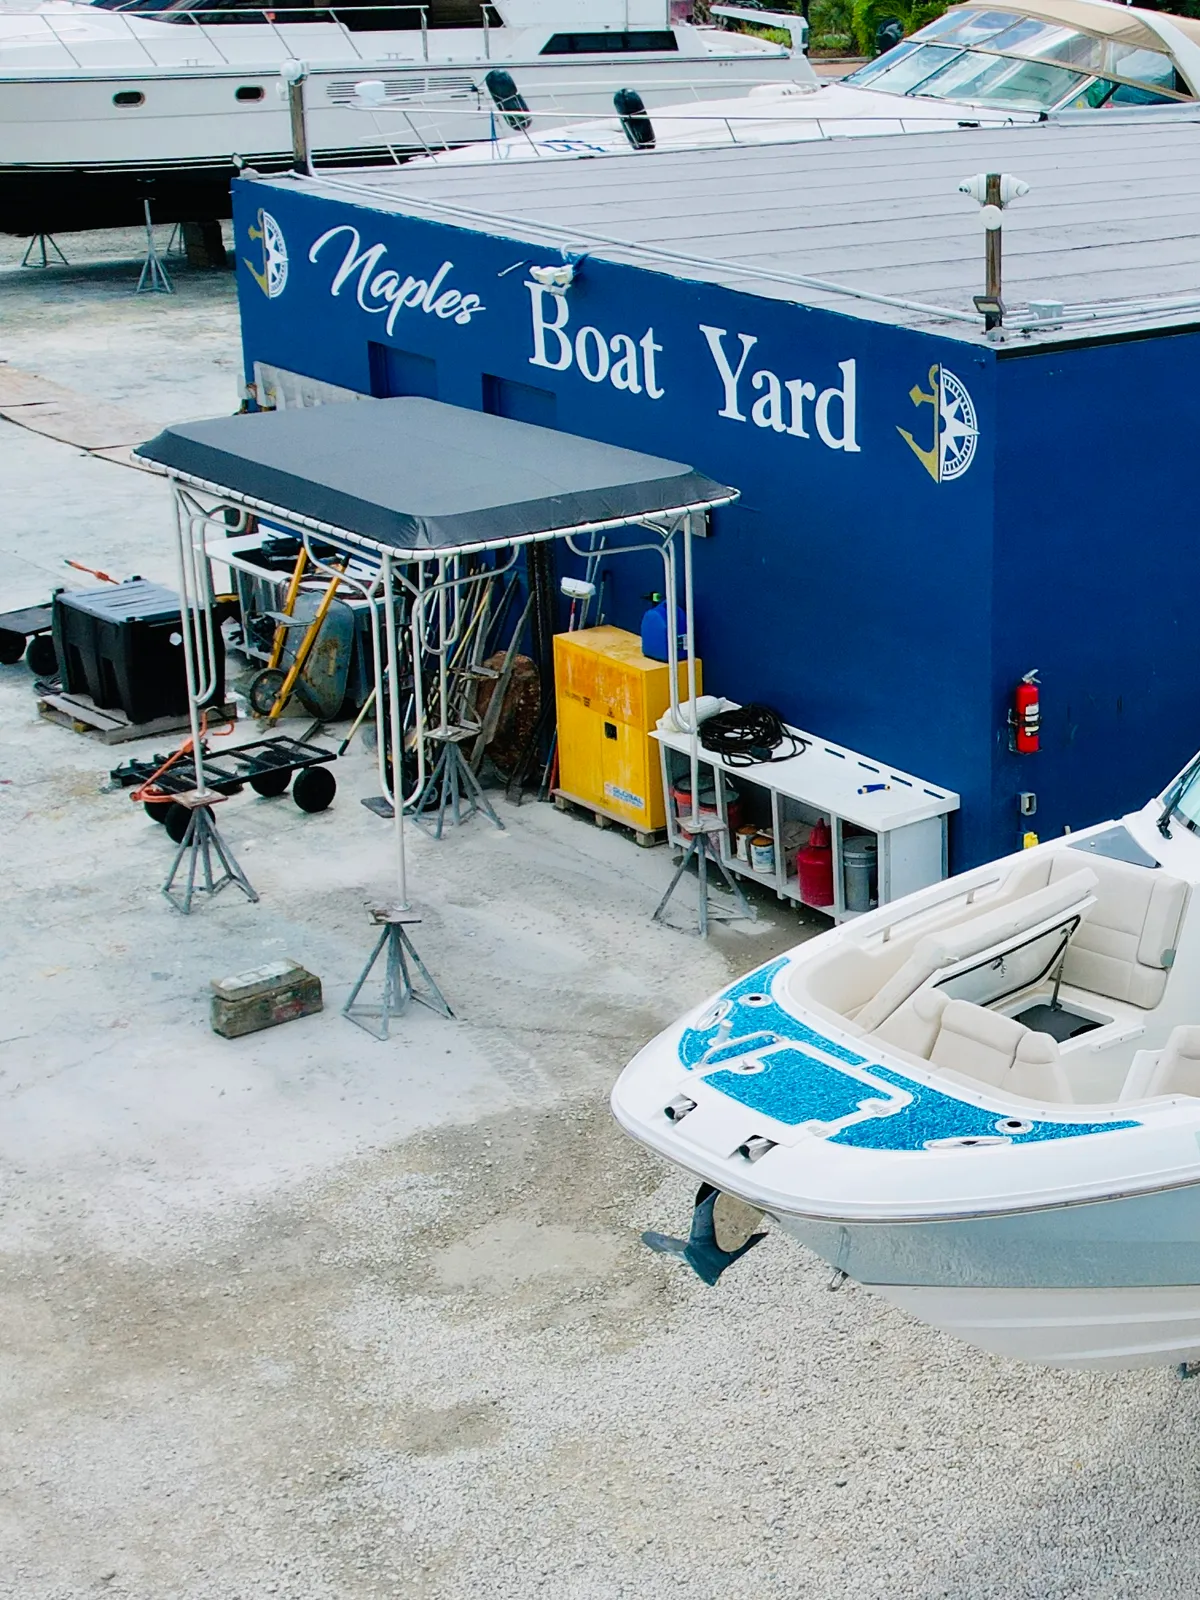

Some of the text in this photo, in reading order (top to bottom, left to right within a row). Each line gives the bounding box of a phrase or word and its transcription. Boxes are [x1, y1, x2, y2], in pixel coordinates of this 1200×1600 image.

[309, 225, 861, 452] Naples Boat Yard
